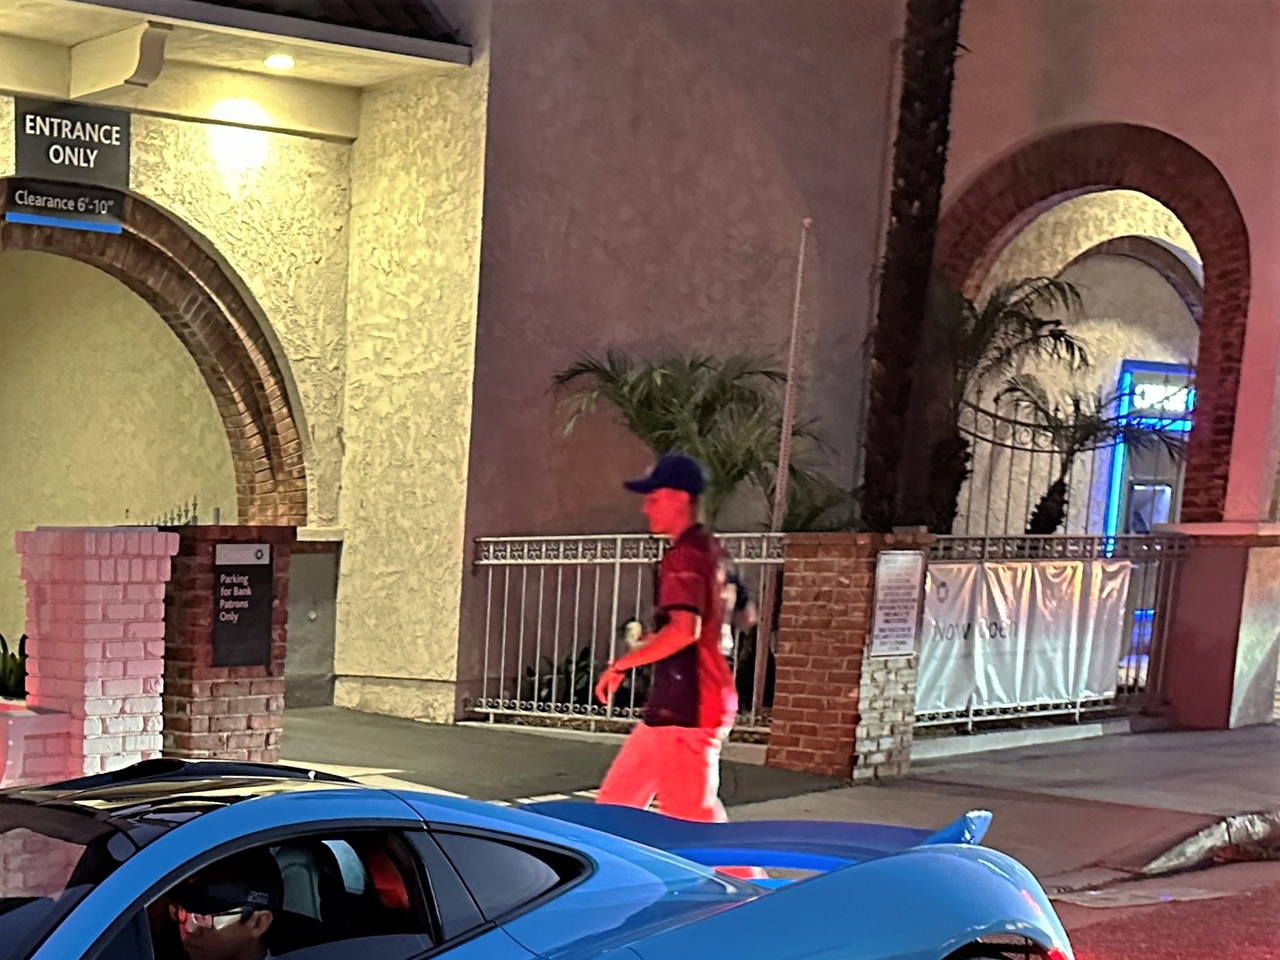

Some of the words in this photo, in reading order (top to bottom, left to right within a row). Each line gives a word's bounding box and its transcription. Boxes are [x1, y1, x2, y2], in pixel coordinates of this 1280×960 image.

[25, 114, 121, 145] ENTRANCE
[48, 144, 98, 168] ONLY
[14, 190, 75, 210] Clearance
[220, 573, 249, 586] Parking
[220, 586, 233, 596] for
[233, 586, 252, 596] Bank
[219, 599, 249, 609] Patrons
[219, 611, 239, 624] Only
